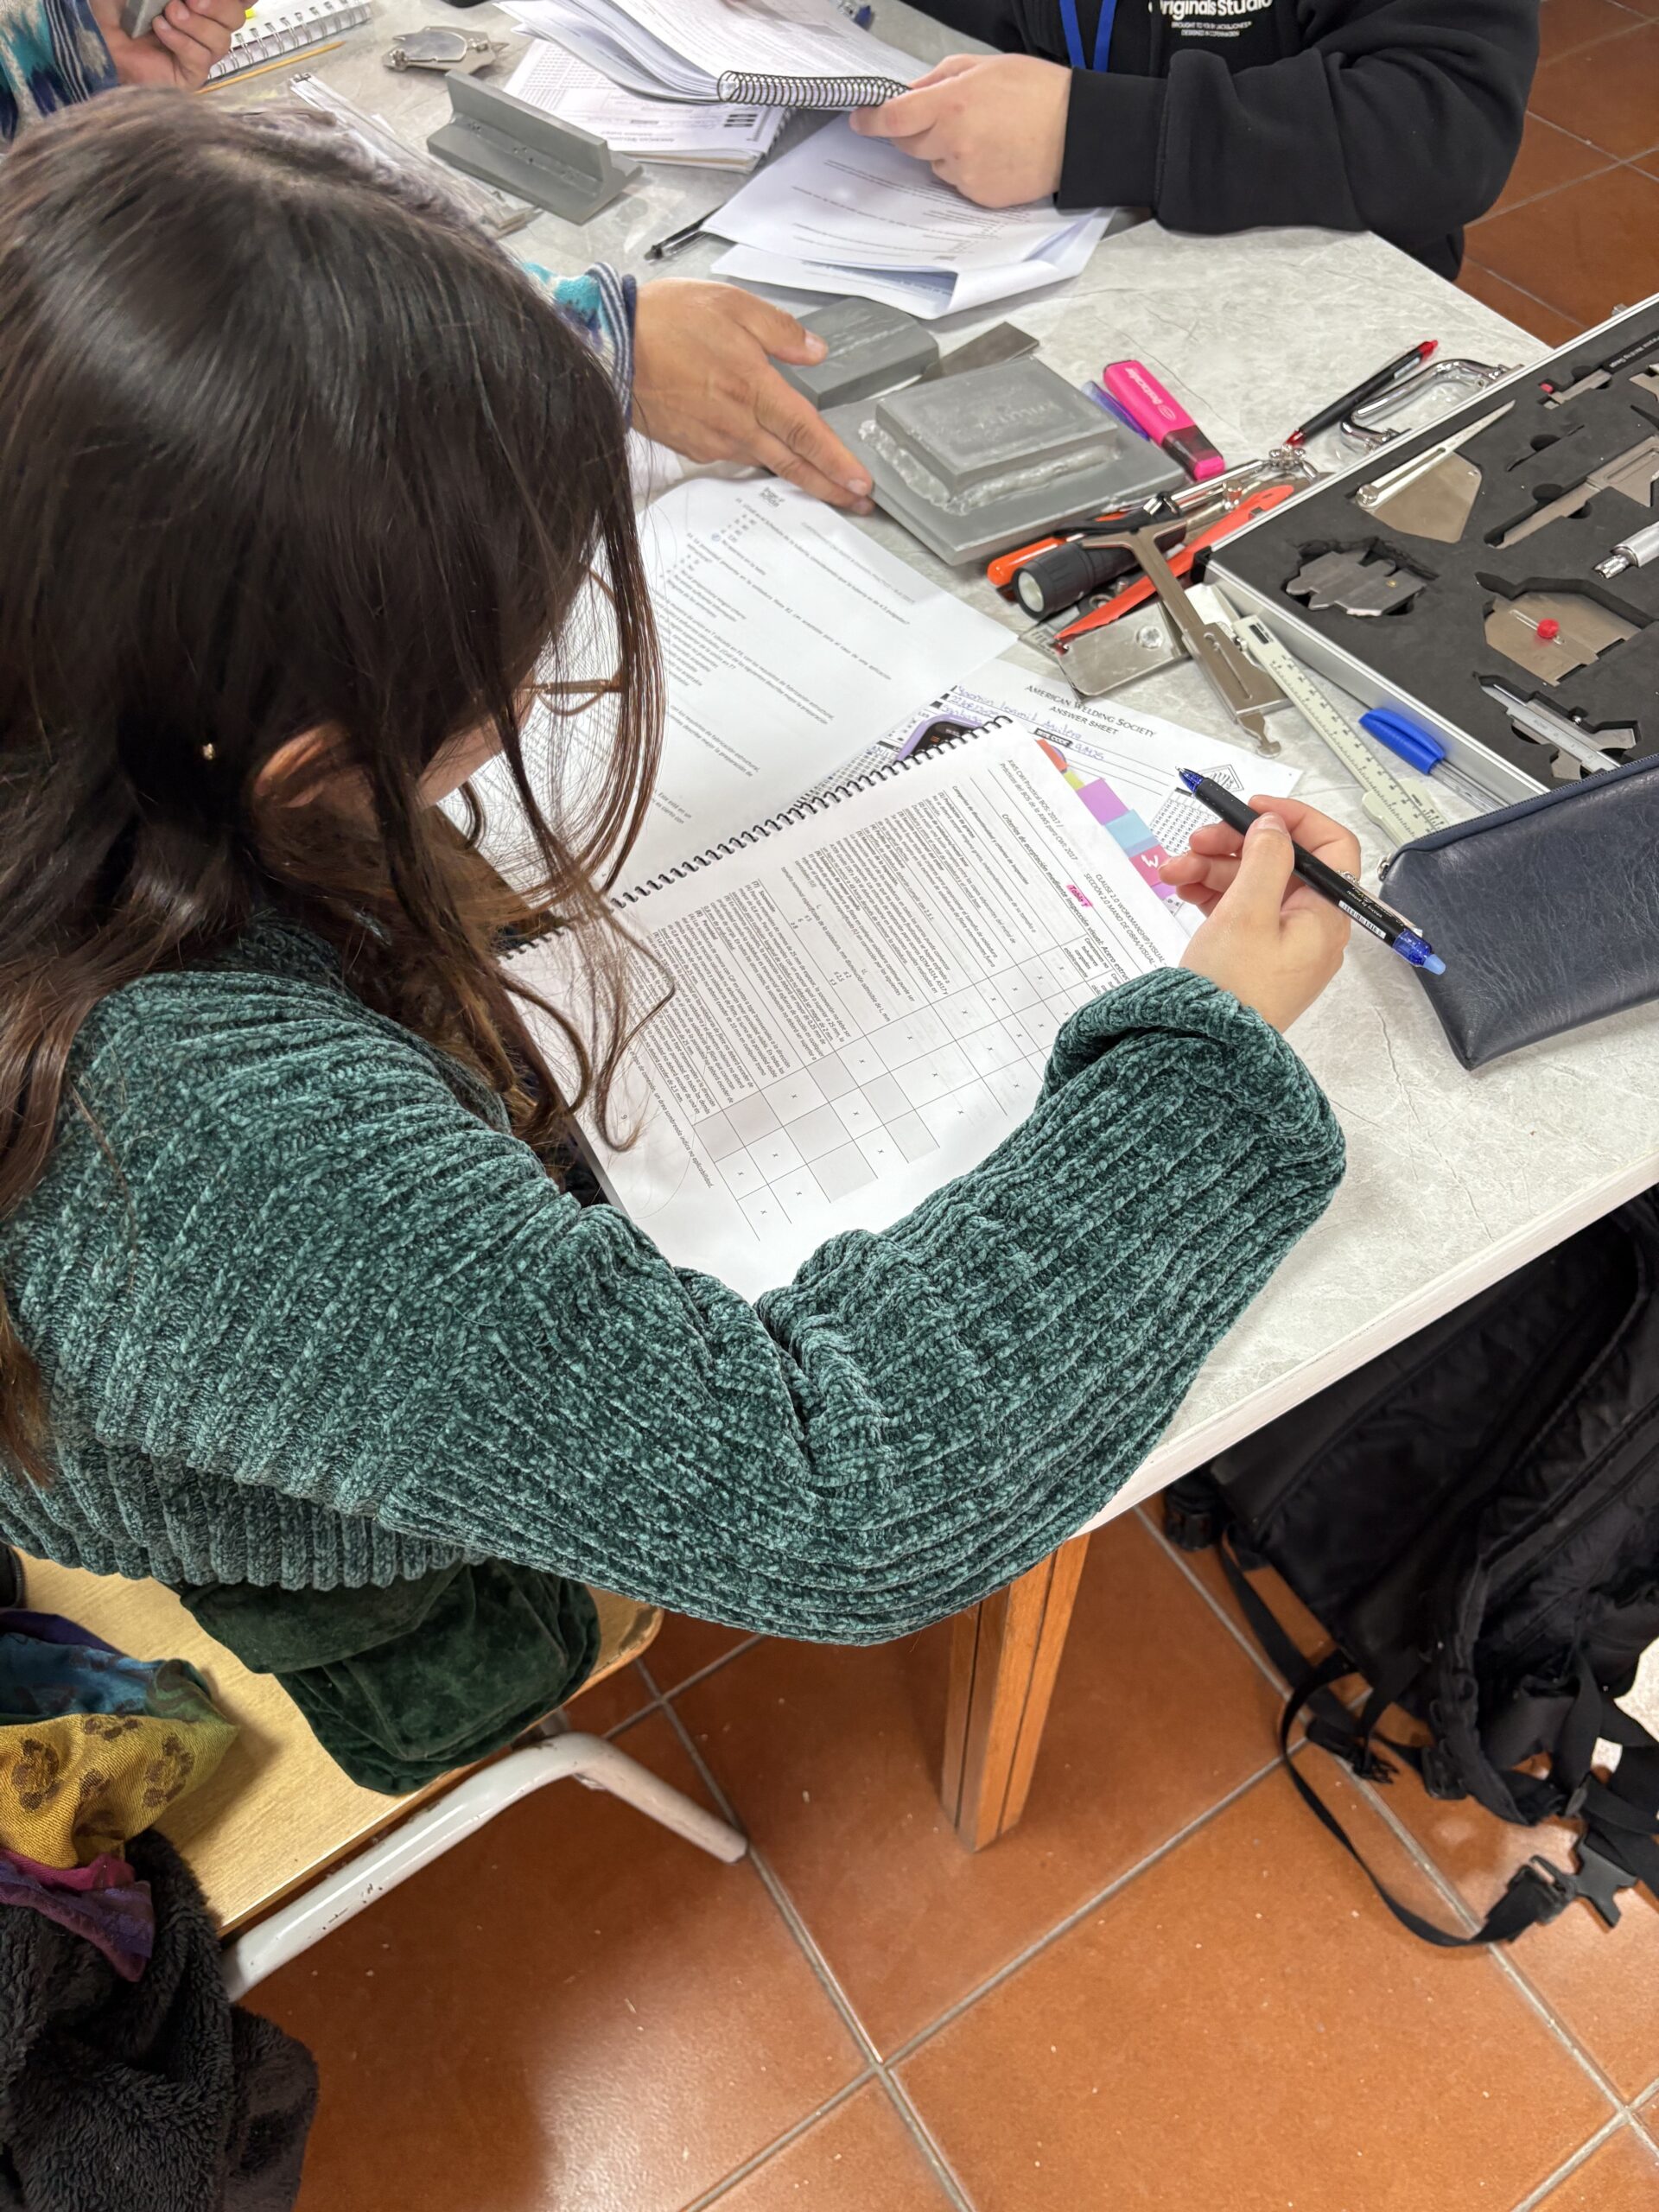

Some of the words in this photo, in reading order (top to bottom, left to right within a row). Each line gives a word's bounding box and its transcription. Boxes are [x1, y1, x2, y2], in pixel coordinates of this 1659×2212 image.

[1024, 684, 1072, 706] AMERICAN
[1071, 702, 1116, 722] WELDING
[1115, 718, 1156, 737] SOCIETY
[1048, 705, 1088, 723] ANSWER
[1087, 720, 1118, 735] SHEET
[998, 762, 1018, 784] Prácticas
[1022, 779, 1042, 801] Practical
[1001, 812, 1022, 836] Criterios
[1021, 842, 1049, 872] aceptación
[1045, 870, 1069, 898] mediante
[1063, 896, 1090, 927] inspección
[1086, 925, 1105, 945] visual:
[1100, 944, 1118, 963] Acero
[1068, 886, 1084, 903] Tabla
[1083, 872, 1104, 896] SECCIÓN
[1123, 928, 1155, 964] OBRA/VISUAL
[1094, 874, 1113, 893] CLAUSE
[1115, 901, 1165, 963] WORKMANSHIP/VISUAL
